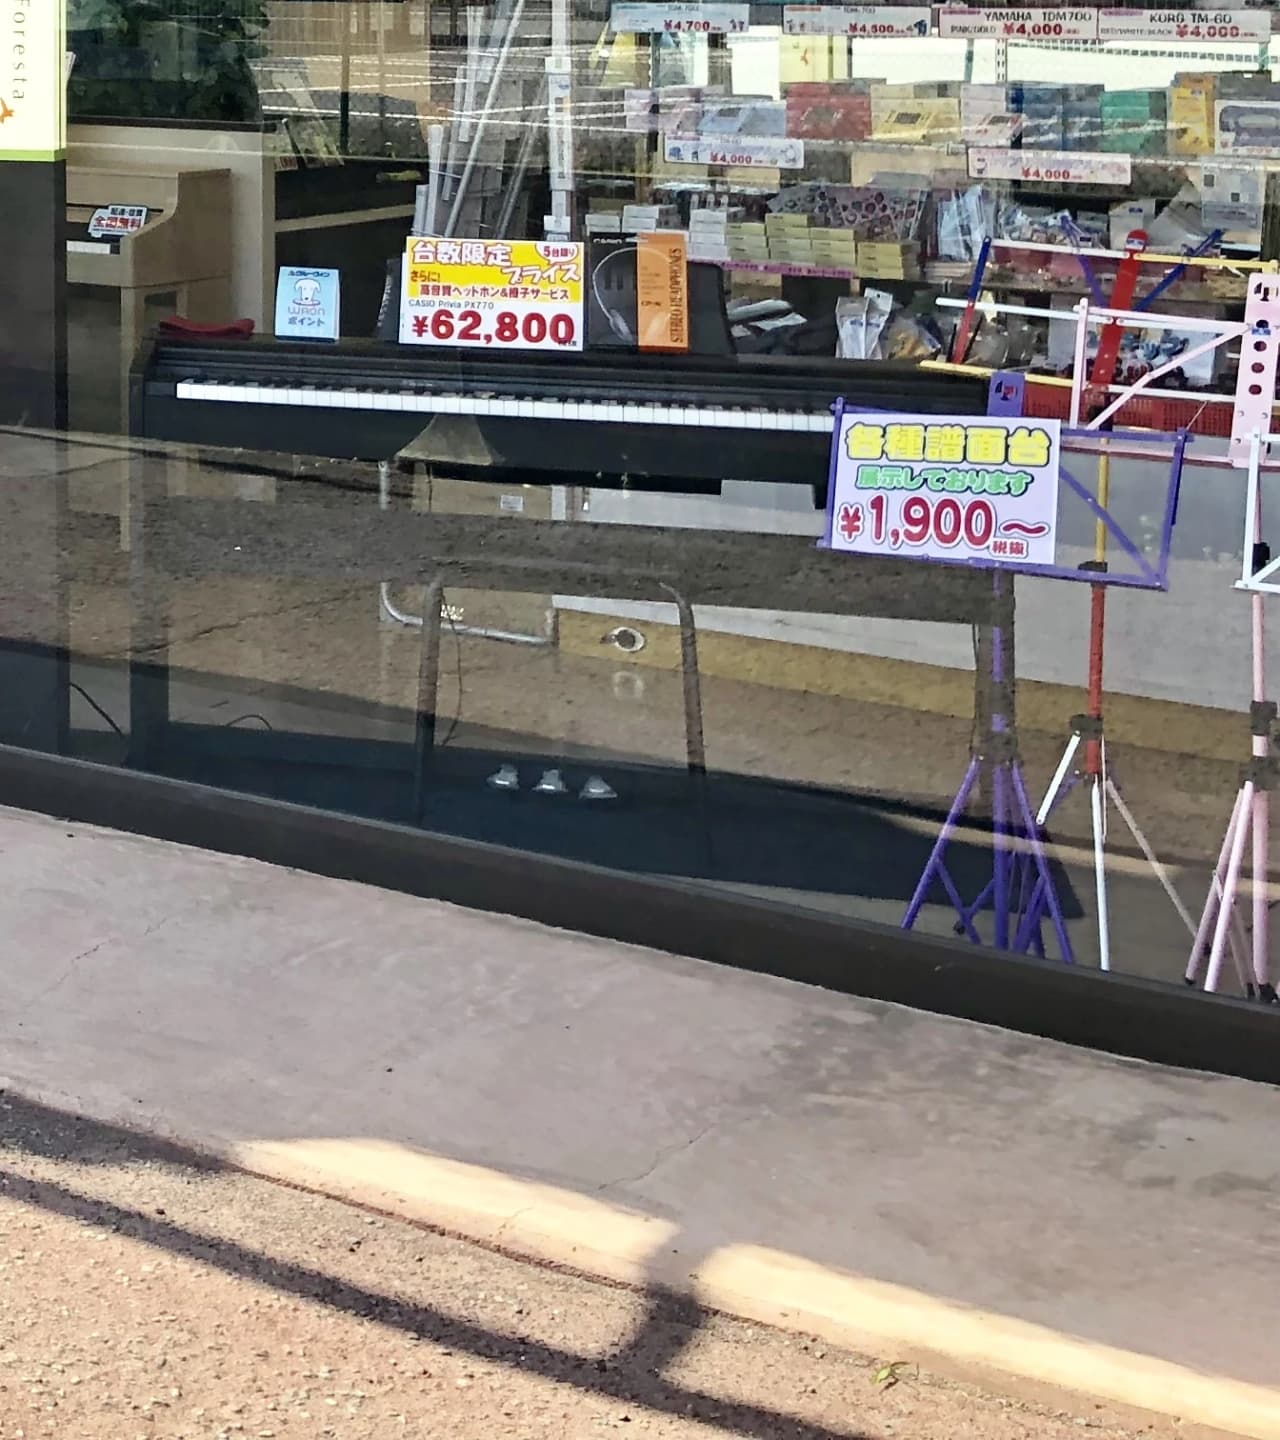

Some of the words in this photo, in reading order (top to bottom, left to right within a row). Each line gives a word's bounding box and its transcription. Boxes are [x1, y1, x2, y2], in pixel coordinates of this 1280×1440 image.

[984, 11, 1033, 23] YAMAHA
[1149, 12, 1185, 24] KORG
[663, 19, 711, 32] ¥4,700
[1003, 22, 1063, 36] ¥4,000
[1175, 25, 1240, 39] ¥4,000
[710, 151, 753, 164] ¥4,000
[1021, 167, 1071, 181] ¥4,000
[413, 241, 512, 267] 台数限定
[410, 270, 441, 282] さらに!
[500, 264, 581, 285] プライス
[408, 299, 436, 308] CASIO
[438, 300, 461, 308] Privia
[287, 316, 326, 327] ポイント
[412, 309, 576, 345] ¥62,800
[845, 423, 1051, 465] 各種譜面台
[856, 465, 1034, 496] 展示しております
